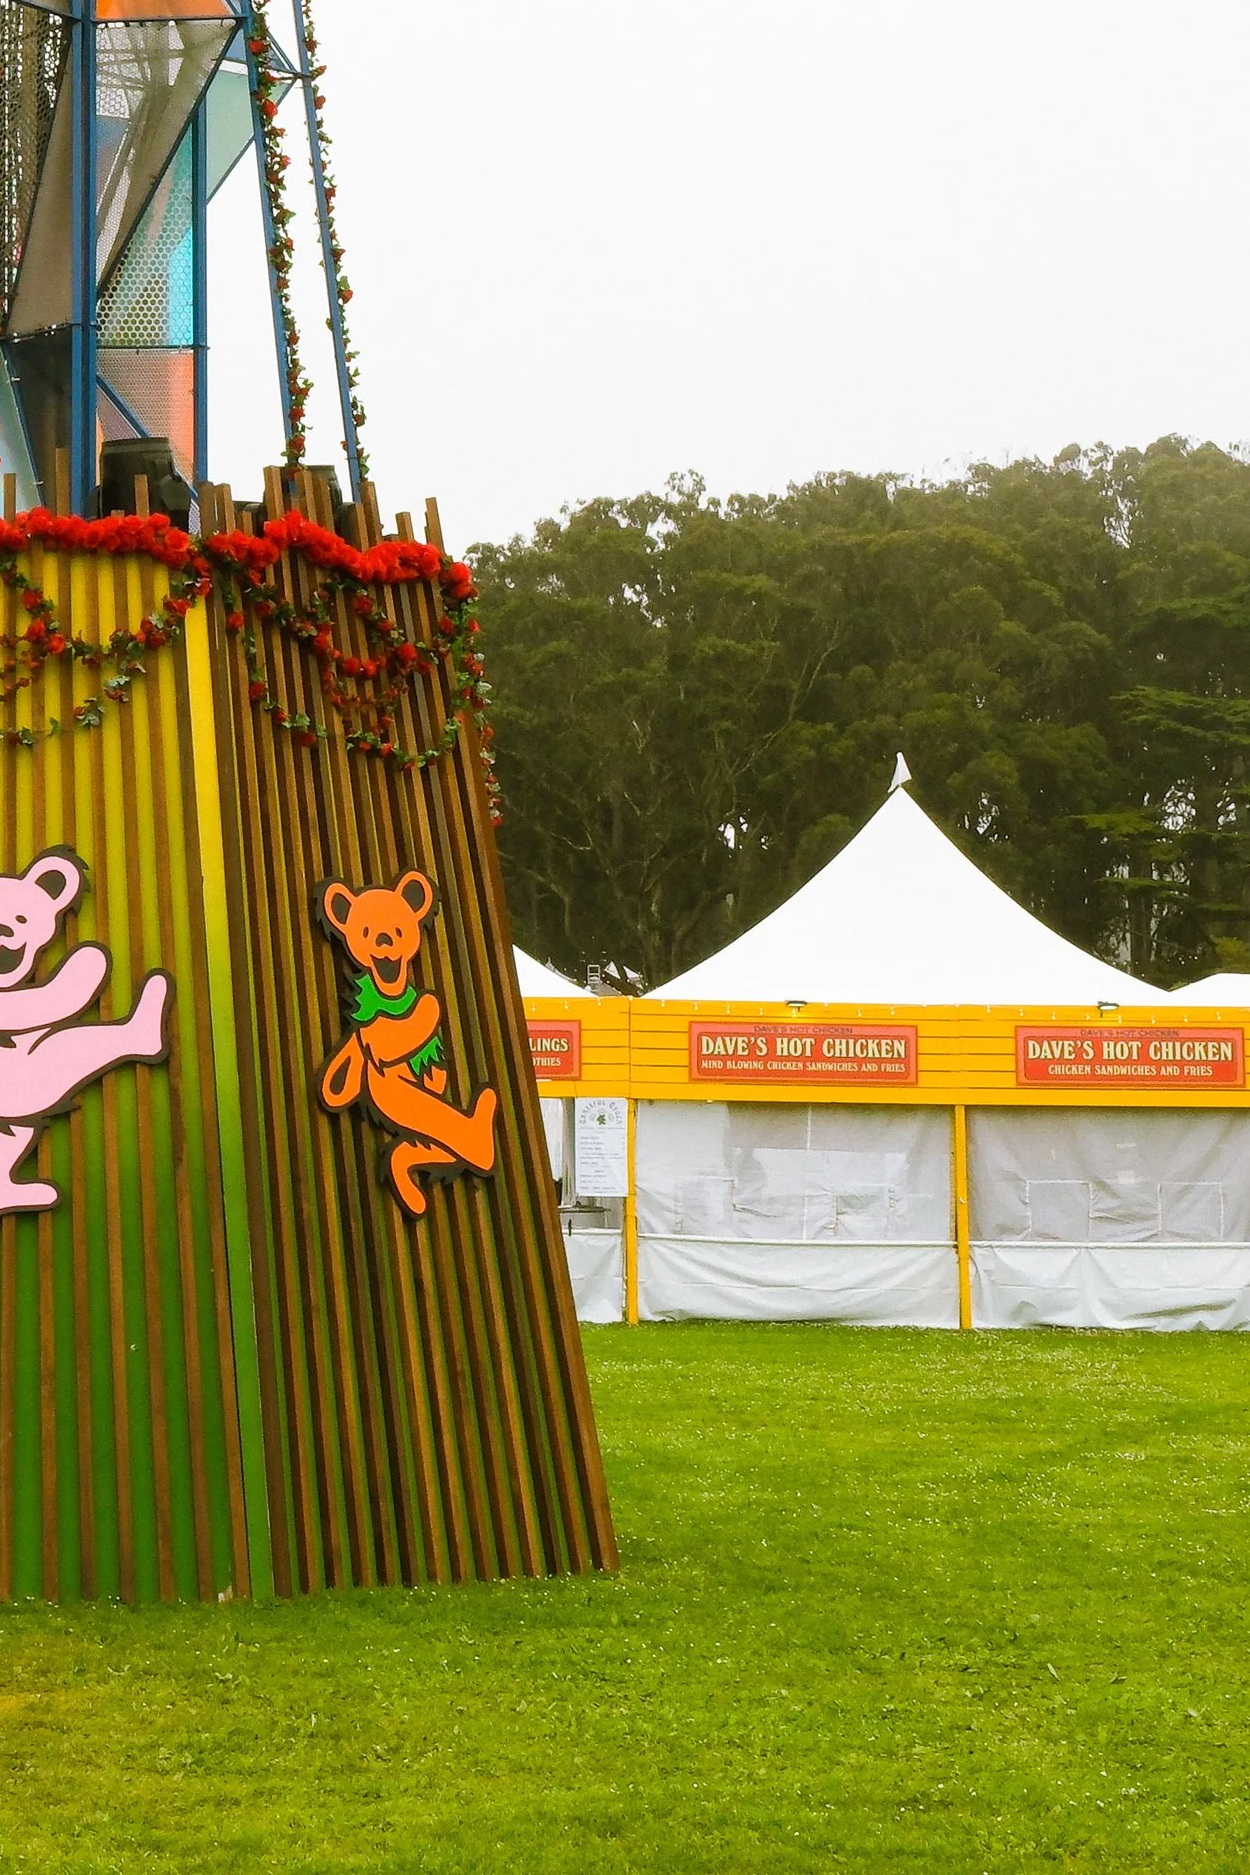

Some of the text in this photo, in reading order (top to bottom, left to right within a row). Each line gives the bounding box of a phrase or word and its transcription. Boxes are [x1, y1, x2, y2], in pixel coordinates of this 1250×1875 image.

[701, 1036, 906, 1059] DAVE'S HOT CHICKEN
[1027, 1040, 1233, 1061] DAVE'S HOT CHICKEN
[701, 1060, 906, 1073] MIND BLOWING CHICKEN SANDWICHES AND FRIES
[1048, 1064, 1213, 1076] CHICKEN SANDWICHES AND FRIES
